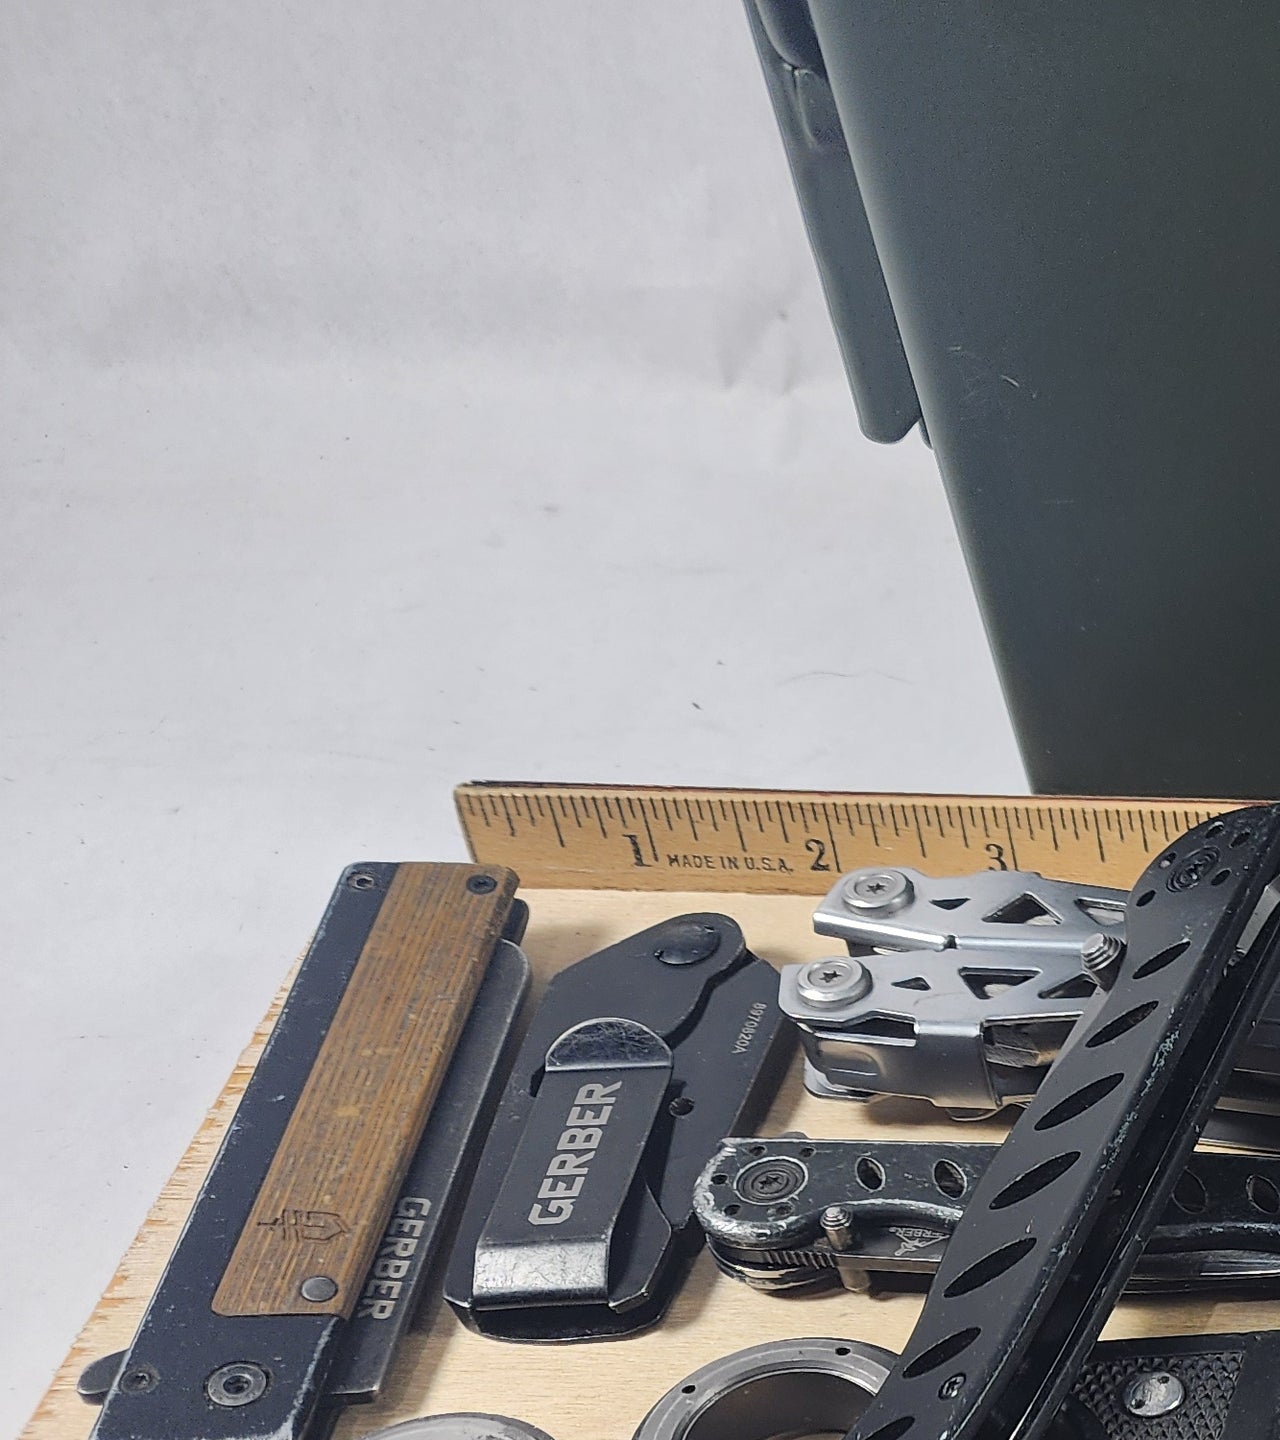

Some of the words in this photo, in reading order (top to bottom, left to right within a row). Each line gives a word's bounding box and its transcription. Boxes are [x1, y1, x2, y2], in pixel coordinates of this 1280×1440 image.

[622, 833, 651, 868] 1
[667, 852, 717, 870] MADE
[718, 854, 740, 871] IN
[742, 855, 795, 874] U.S.A.
[805, 838, 831, 872] 2
[528, 1080, 623, 1226] GERBER
[357, 1196, 432, 1320] GERBER
